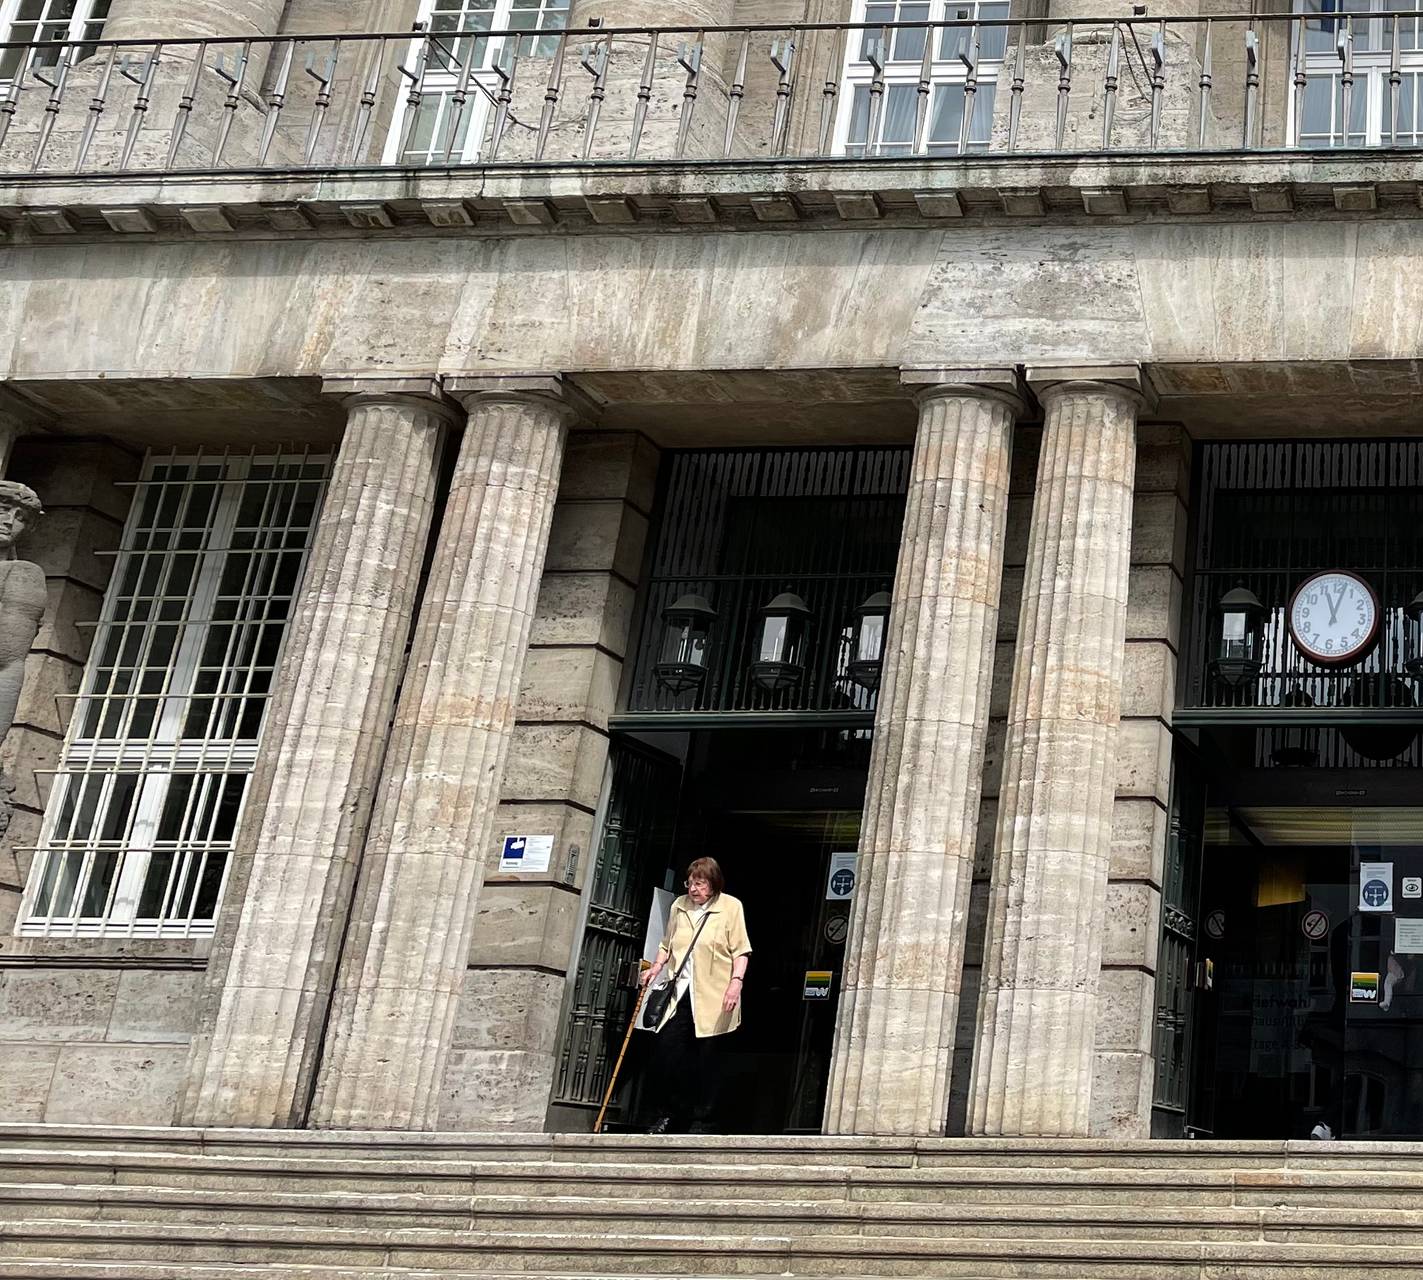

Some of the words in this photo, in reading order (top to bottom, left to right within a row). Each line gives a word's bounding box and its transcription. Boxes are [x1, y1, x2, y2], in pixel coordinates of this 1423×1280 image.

[1320, 584, 1329, 595] 11
[1333, 583, 1343, 593] 12
[1306, 594, 1318, 605] 10
[1356, 600, 1365, 610] 2
[1302, 608, 1310, 618] 9
[1358, 614, 1366, 625] 3
[1303, 622, 1311, 633] 8
[1351, 628, 1360, 638] 4
[1312, 633, 1320, 644] 7
[1325, 639, 1333, 649] 6
[1340, 637, 1348, 648] 5
